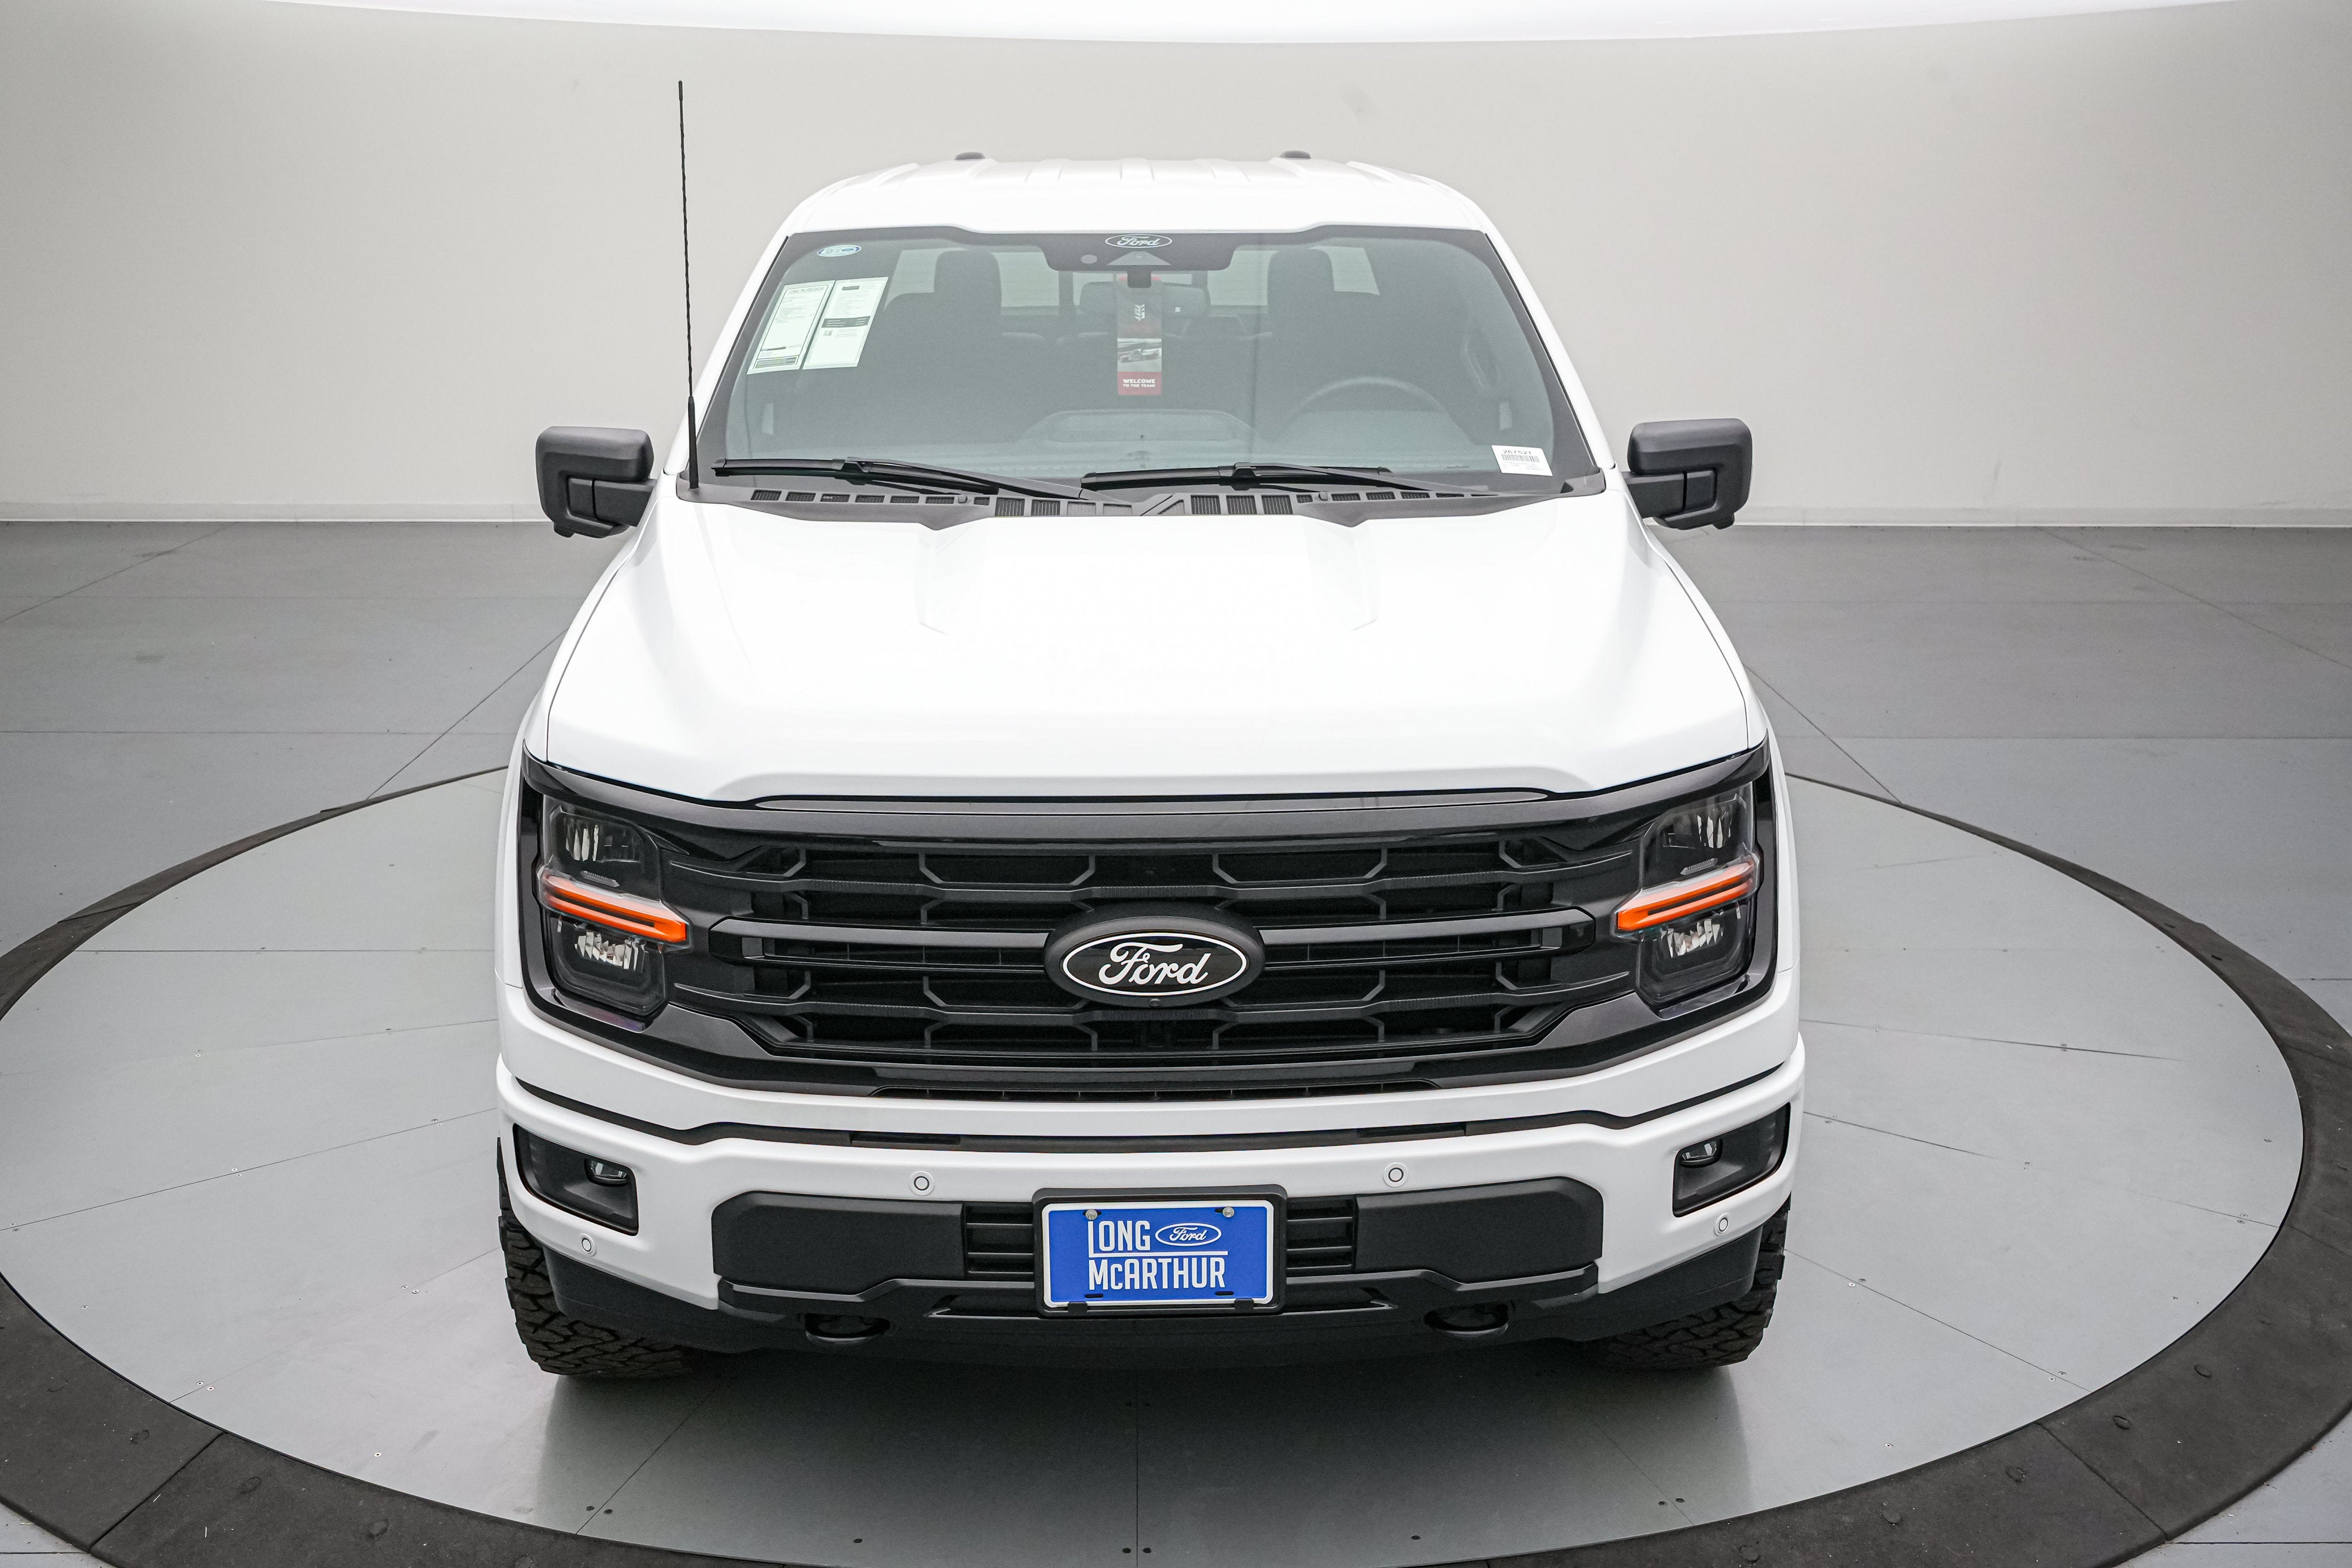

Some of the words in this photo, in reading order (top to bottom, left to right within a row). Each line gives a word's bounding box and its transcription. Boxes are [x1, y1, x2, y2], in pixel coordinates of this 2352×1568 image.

[1117, 235, 1161, 246] Ford
[1098, 942, 1211, 985] Ford
[1087, 1221, 1150, 1258] LONG
[1169, 1226, 1207, 1242] Ford
[1088, 1257, 1225, 1290] McARTHUR
